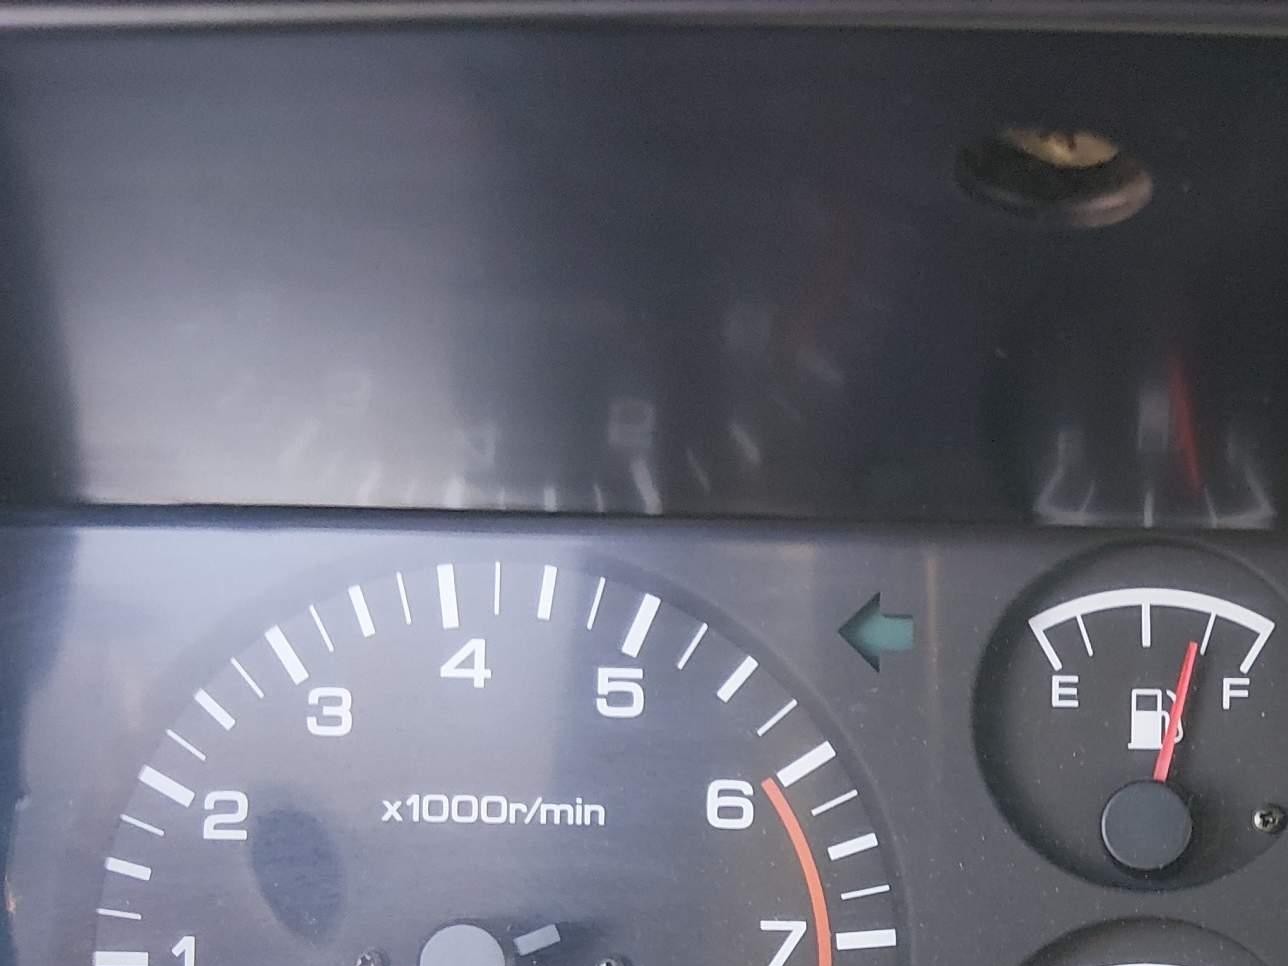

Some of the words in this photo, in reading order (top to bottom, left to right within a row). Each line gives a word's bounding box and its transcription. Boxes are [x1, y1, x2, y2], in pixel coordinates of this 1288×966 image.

[440, 638, 492, 688] 4
[306, 686, 353, 737] 3
[595, 667, 645, 718] 5
[1051, 674, 1079, 708] E
[1222, 677, 1250, 710] F
[203, 790, 249, 840] 2
[381, 793, 605, 826] x1000r/min
[706, 779, 754, 830] 6
